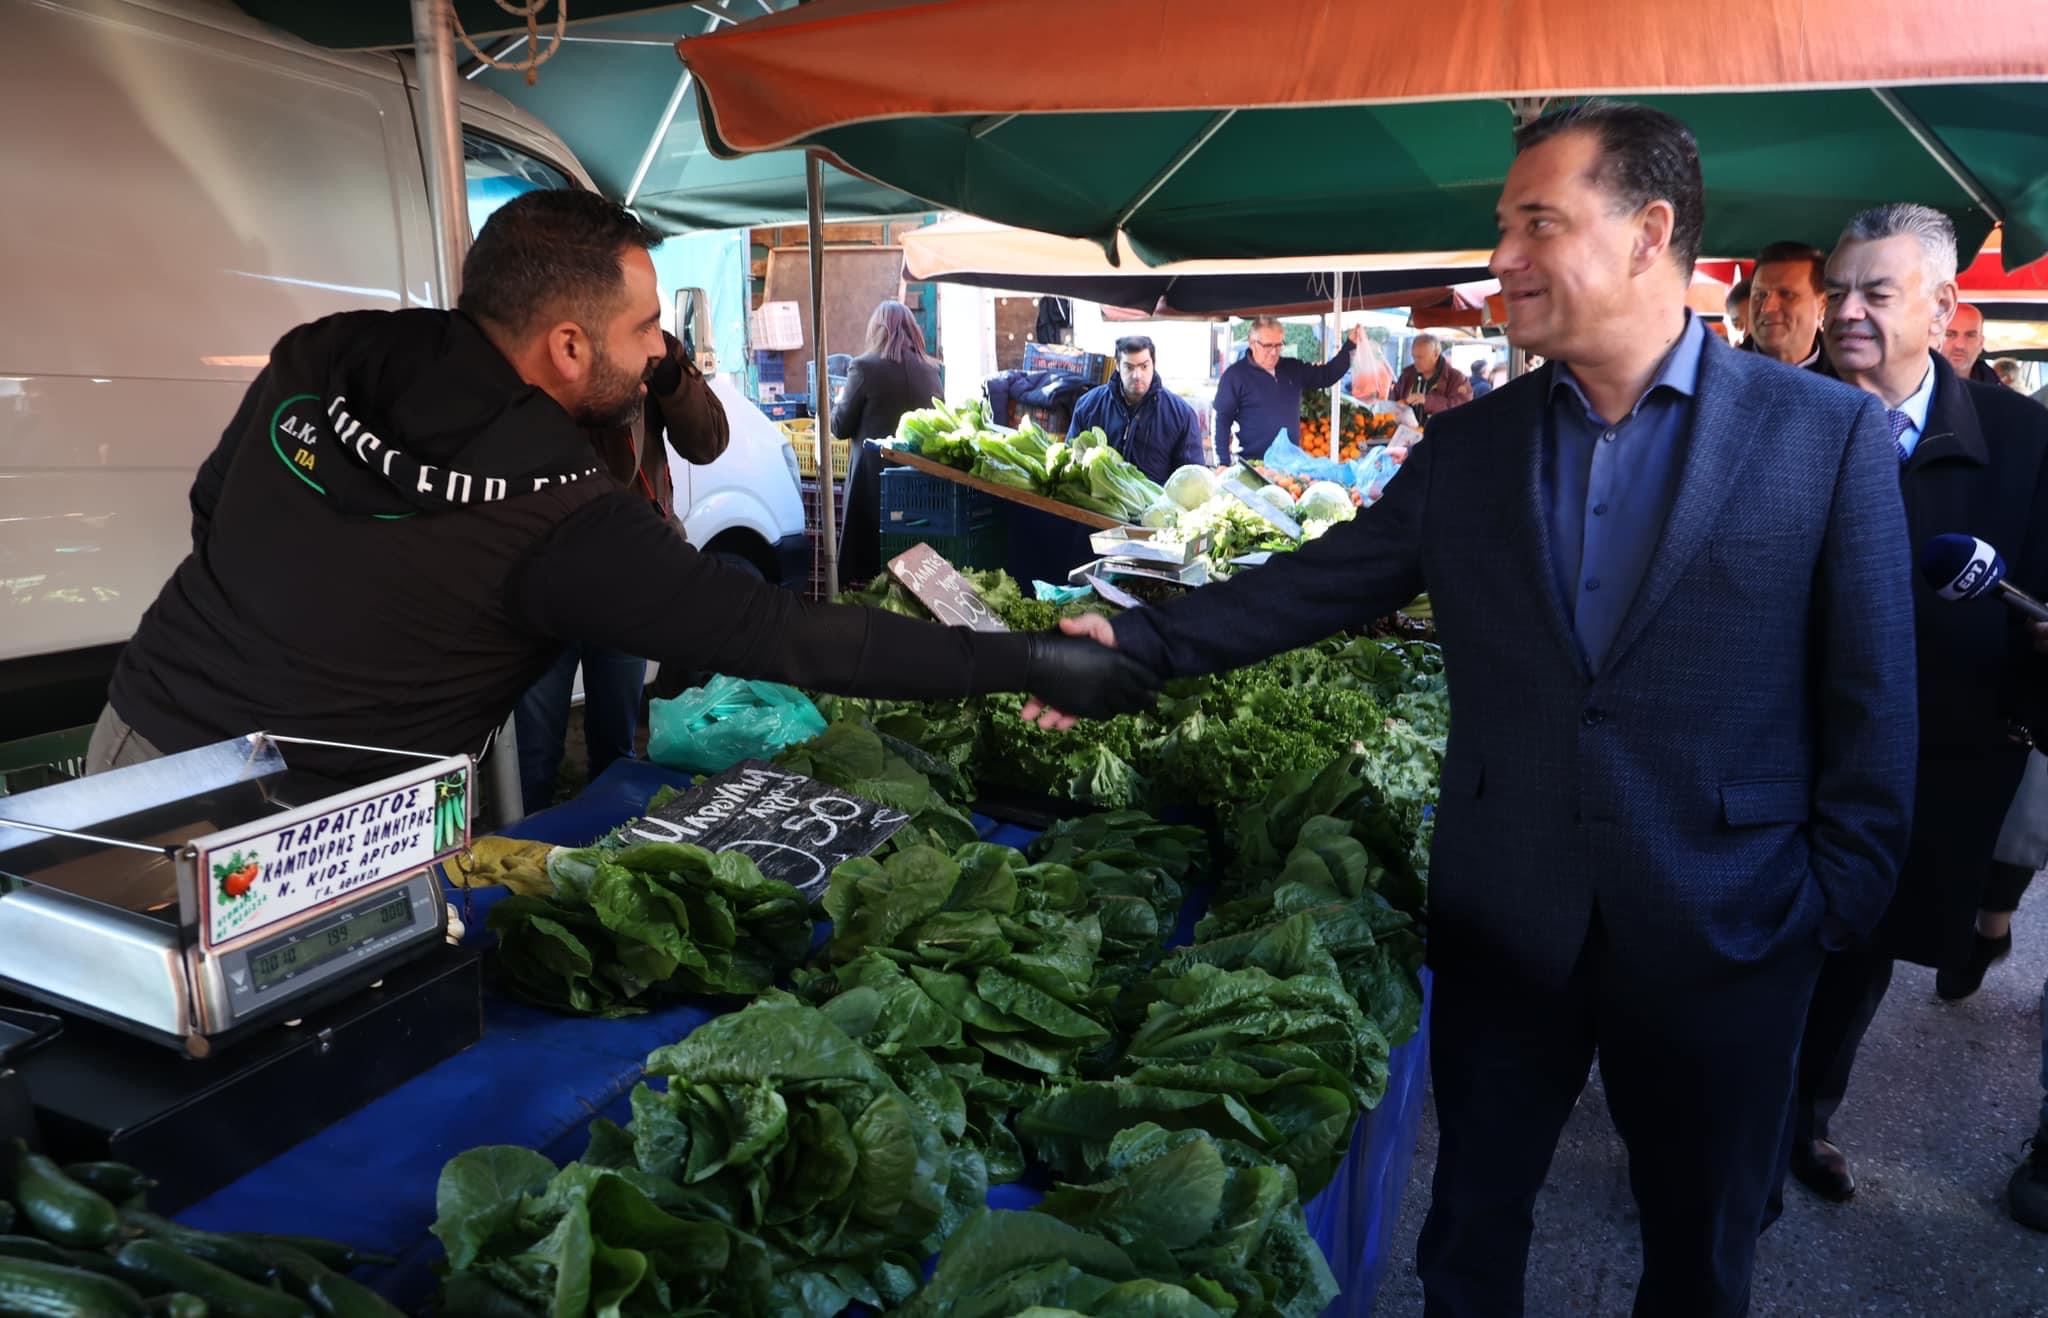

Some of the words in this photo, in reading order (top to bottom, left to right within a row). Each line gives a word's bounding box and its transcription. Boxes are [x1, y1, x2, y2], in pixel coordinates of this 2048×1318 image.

[1957, 562, 1983, 590] ΕΡΤ
[262, 834, 356, 883] ΚΑΜΠΟΥΡΗΣ
[362, 806, 434, 847] ΔΗΜΗΤΡΗΣ
[276, 788, 420, 853] ΠΑΡΑΓΩΓΟΣ
[277, 881, 296, 898] Ν.
[306, 859, 350, 888] ΚΙΟΣ
[359, 833, 420, 867] ΑΡΓΟΥΣ
